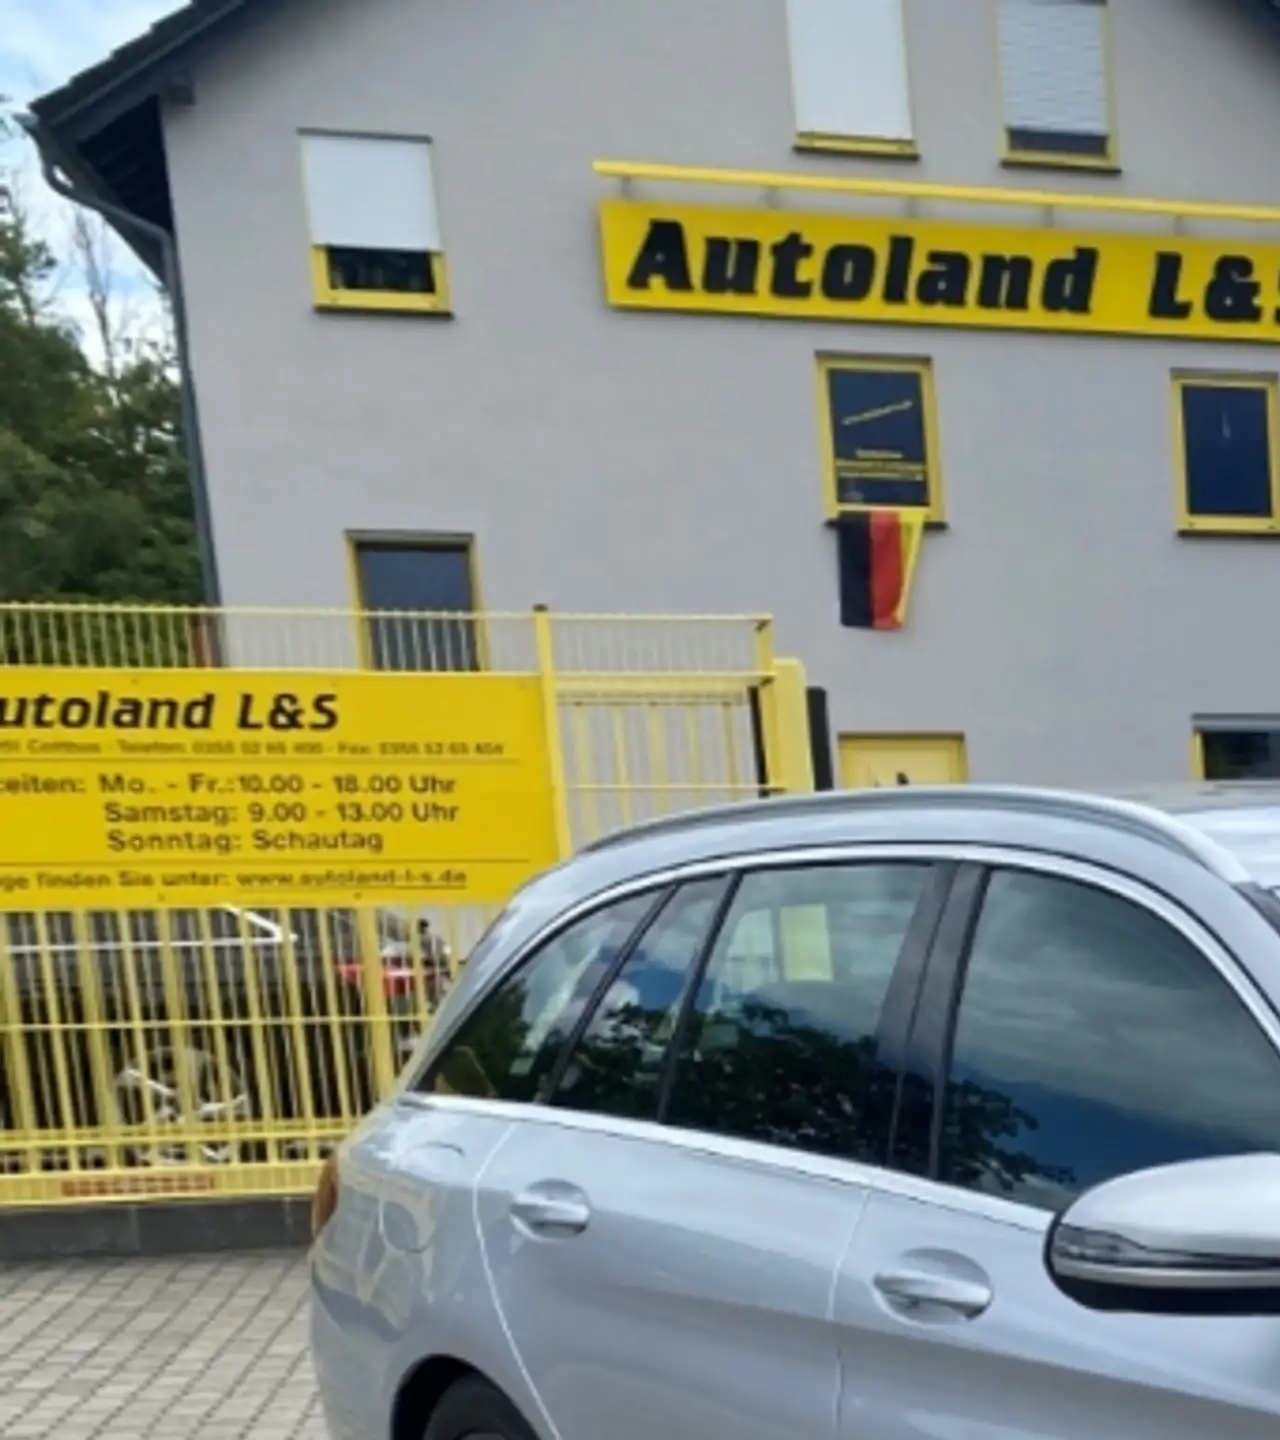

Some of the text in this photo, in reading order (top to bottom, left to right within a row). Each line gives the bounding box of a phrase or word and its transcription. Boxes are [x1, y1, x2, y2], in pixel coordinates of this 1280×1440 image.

[626, 218, 1099, 314] Autoland
[238, 693, 339, 731] L&S
[99, 773, 156, 794] Mo.
[333, 774, 403, 794] 18.00
[408, 774, 457, 794] Uhr
[104, 801, 239, 826] Samstag:
[248, 801, 307, 823] 9.00
[336, 801, 404, 823] 13.00
[411, 801, 460, 823] Uhr
[107, 829, 384, 854] Sonntag: Schautag
[36, 871, 112, 888] finden
[118, 870, 155, 887] Sie
